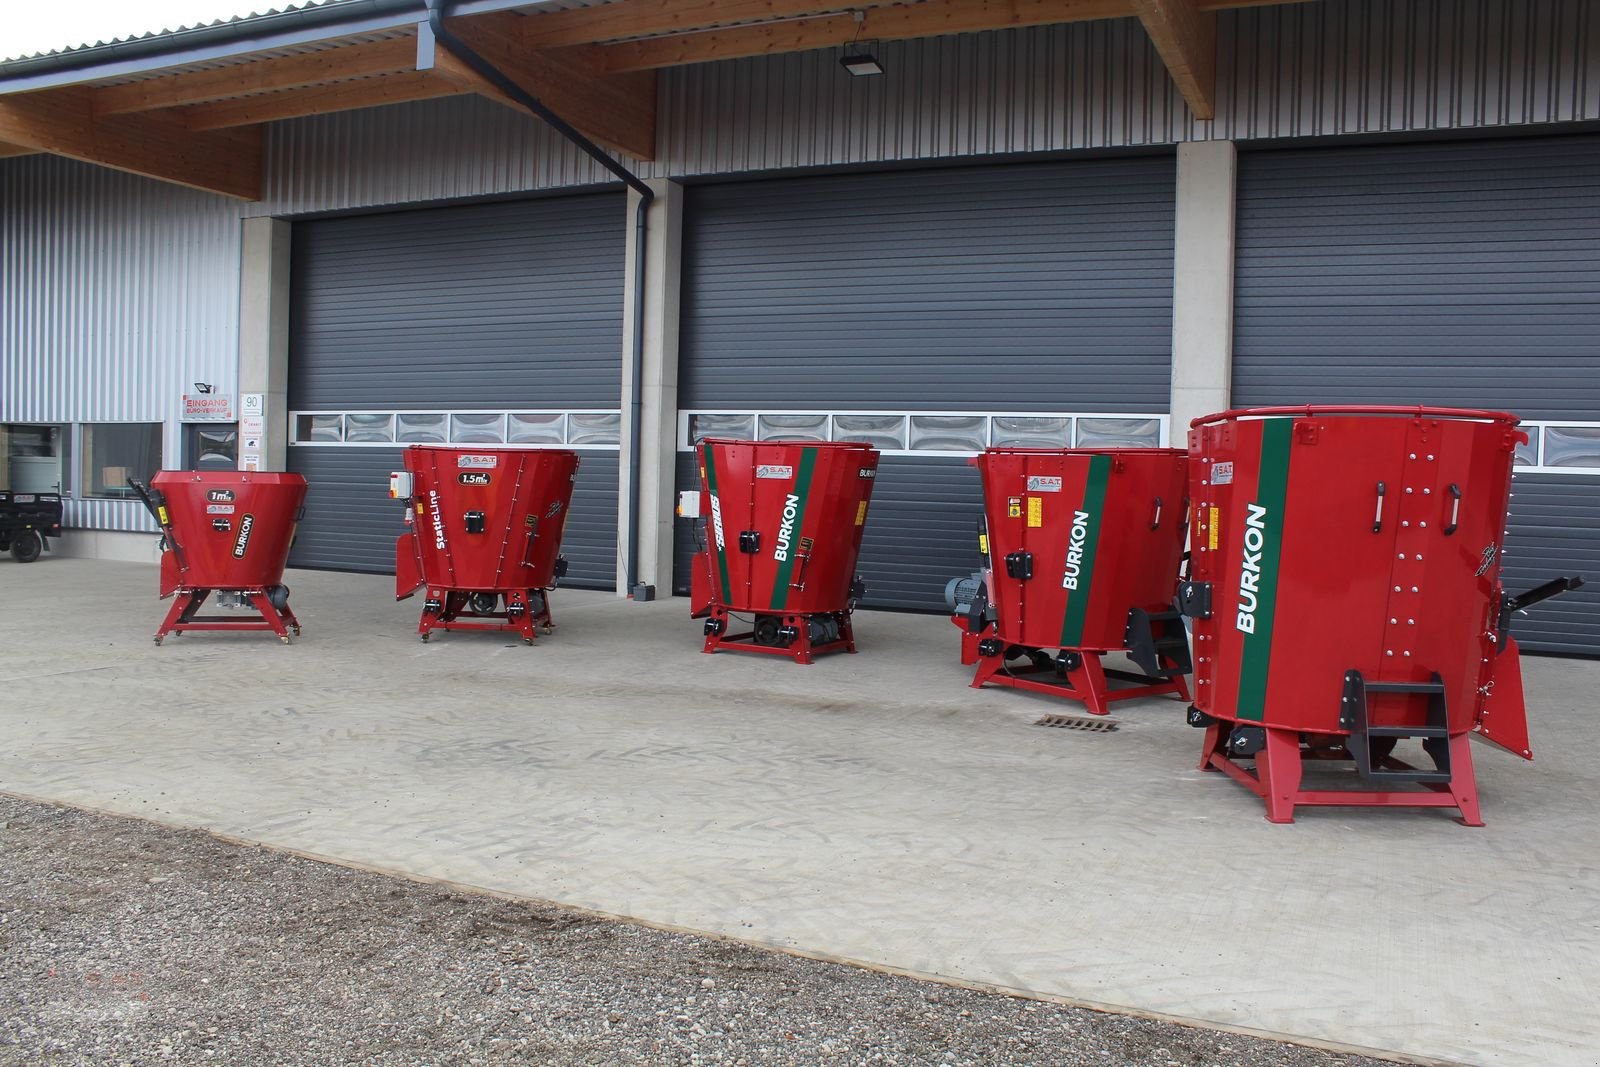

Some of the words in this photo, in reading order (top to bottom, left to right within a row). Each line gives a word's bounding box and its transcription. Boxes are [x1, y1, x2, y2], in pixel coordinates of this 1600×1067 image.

[186, 399, 228, 407] EINGANG
[246, 396, 258, 408] 90
[235, 517, 253, 556] BURKON
[429, 490, 445, 550] StaticLine
[774, 493, 799, 562] BURKON
[1062, 510, 1089, 590] BURKON
[1236, 503, 1267, 634] BURKON
